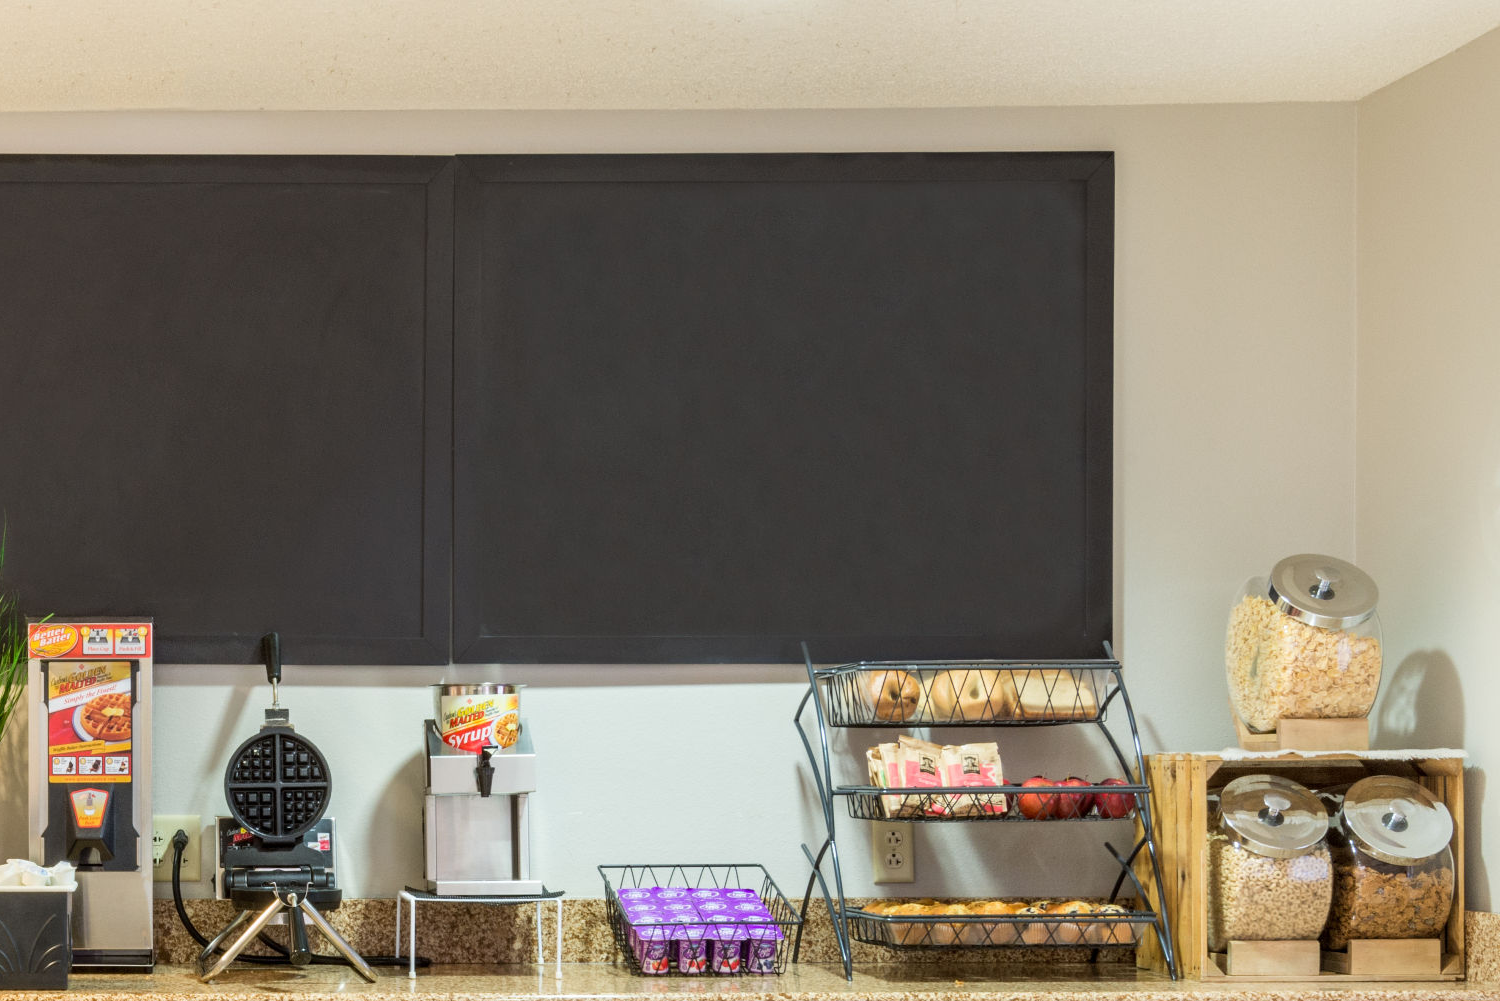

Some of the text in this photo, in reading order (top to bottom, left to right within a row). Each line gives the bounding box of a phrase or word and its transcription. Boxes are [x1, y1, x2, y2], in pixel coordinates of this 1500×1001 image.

[33, 627, 66, 641] Better
[39, 632, 72, 647] Batter
[67, 665, 107, 681] GOLDEN
[59, 676, 97, 692] MALTED
[457, 699, 494, 718] GOLDEN
[449, 711, 485, 728] MALTED
[448, 726, 492, 749] Syrup
